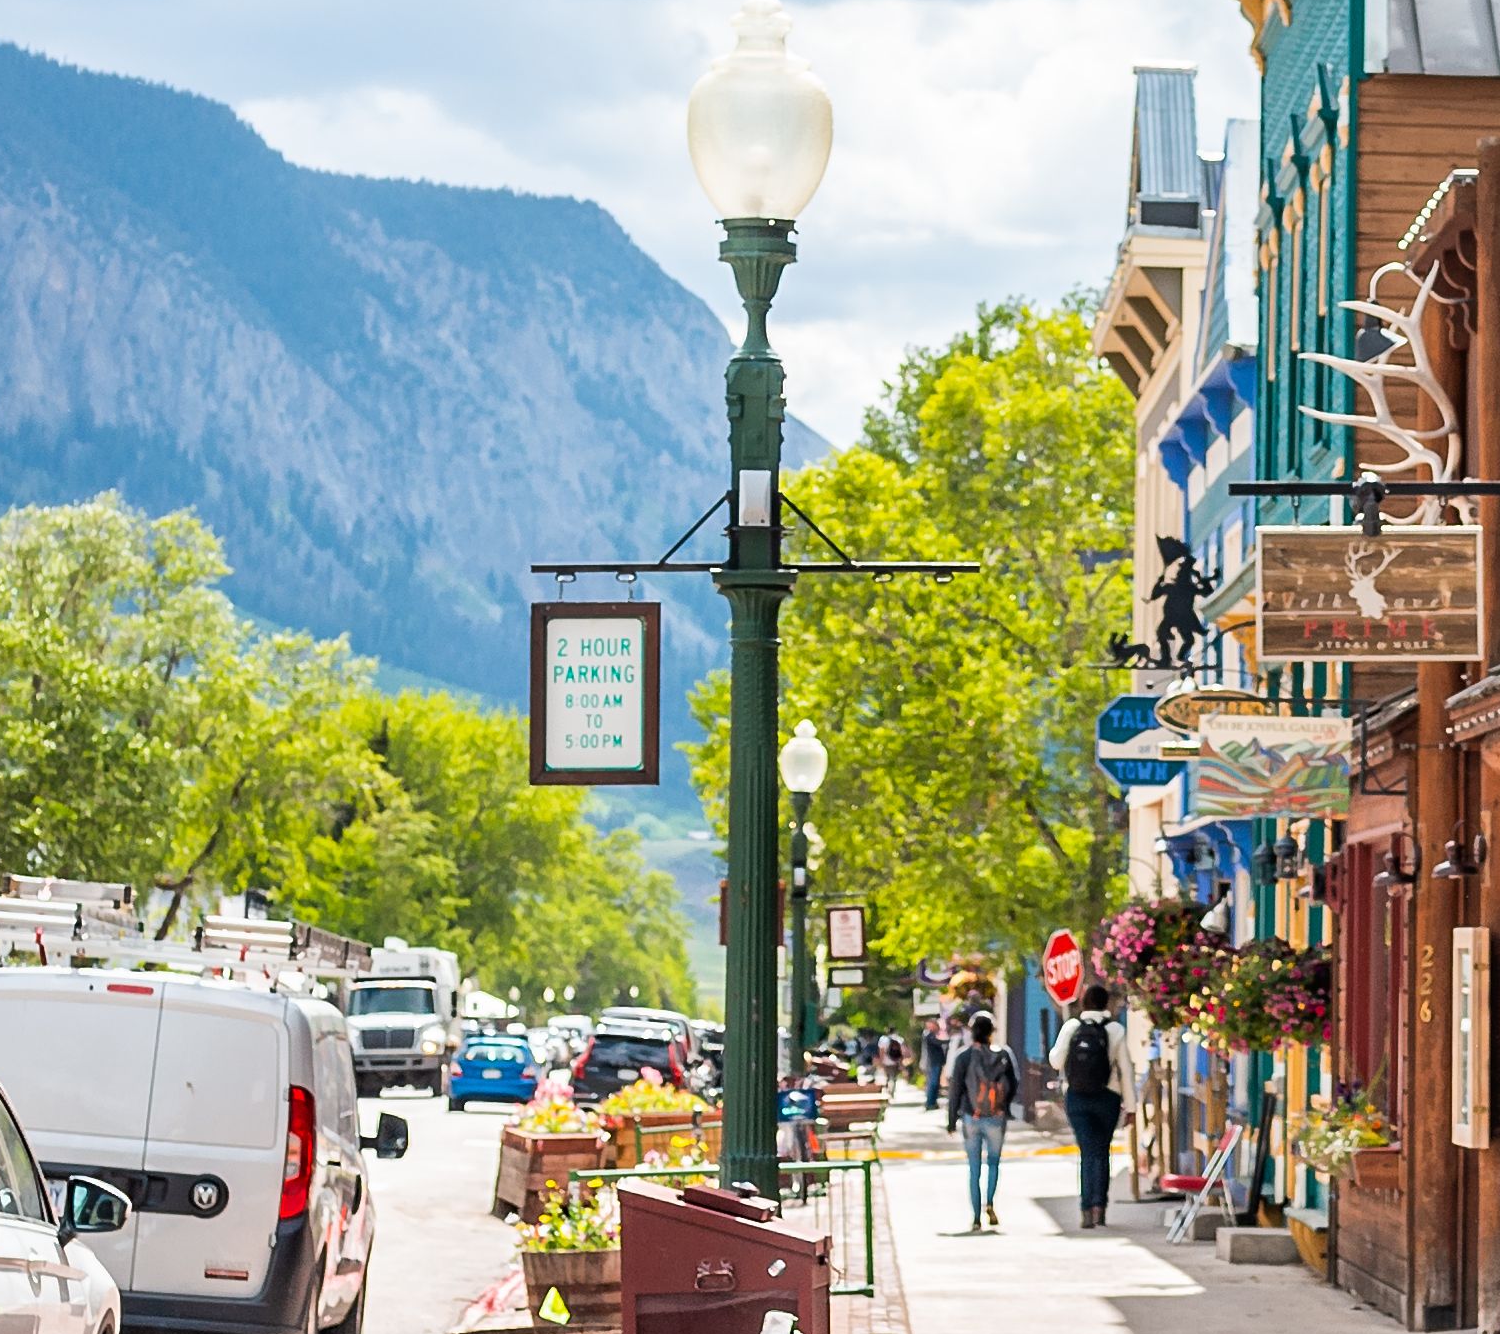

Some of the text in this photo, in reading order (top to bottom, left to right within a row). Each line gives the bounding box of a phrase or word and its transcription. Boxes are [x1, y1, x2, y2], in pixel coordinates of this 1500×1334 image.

[1303, 619, 1438, 640] PRIME
[557, 638, 632, 657] 2 HOUR
[553, 665, 635, 684] PARKING
[565, 694, 623, 708] 8:00 AM
[586, 714, 603, 729] TO
[565, 734, 623, 749] 5:00 PM
[1115, 761, 1169, 781] TOWN
[1046, 948, 1079, 986] STOP
[1419, 944, 1435, 1024] 226
